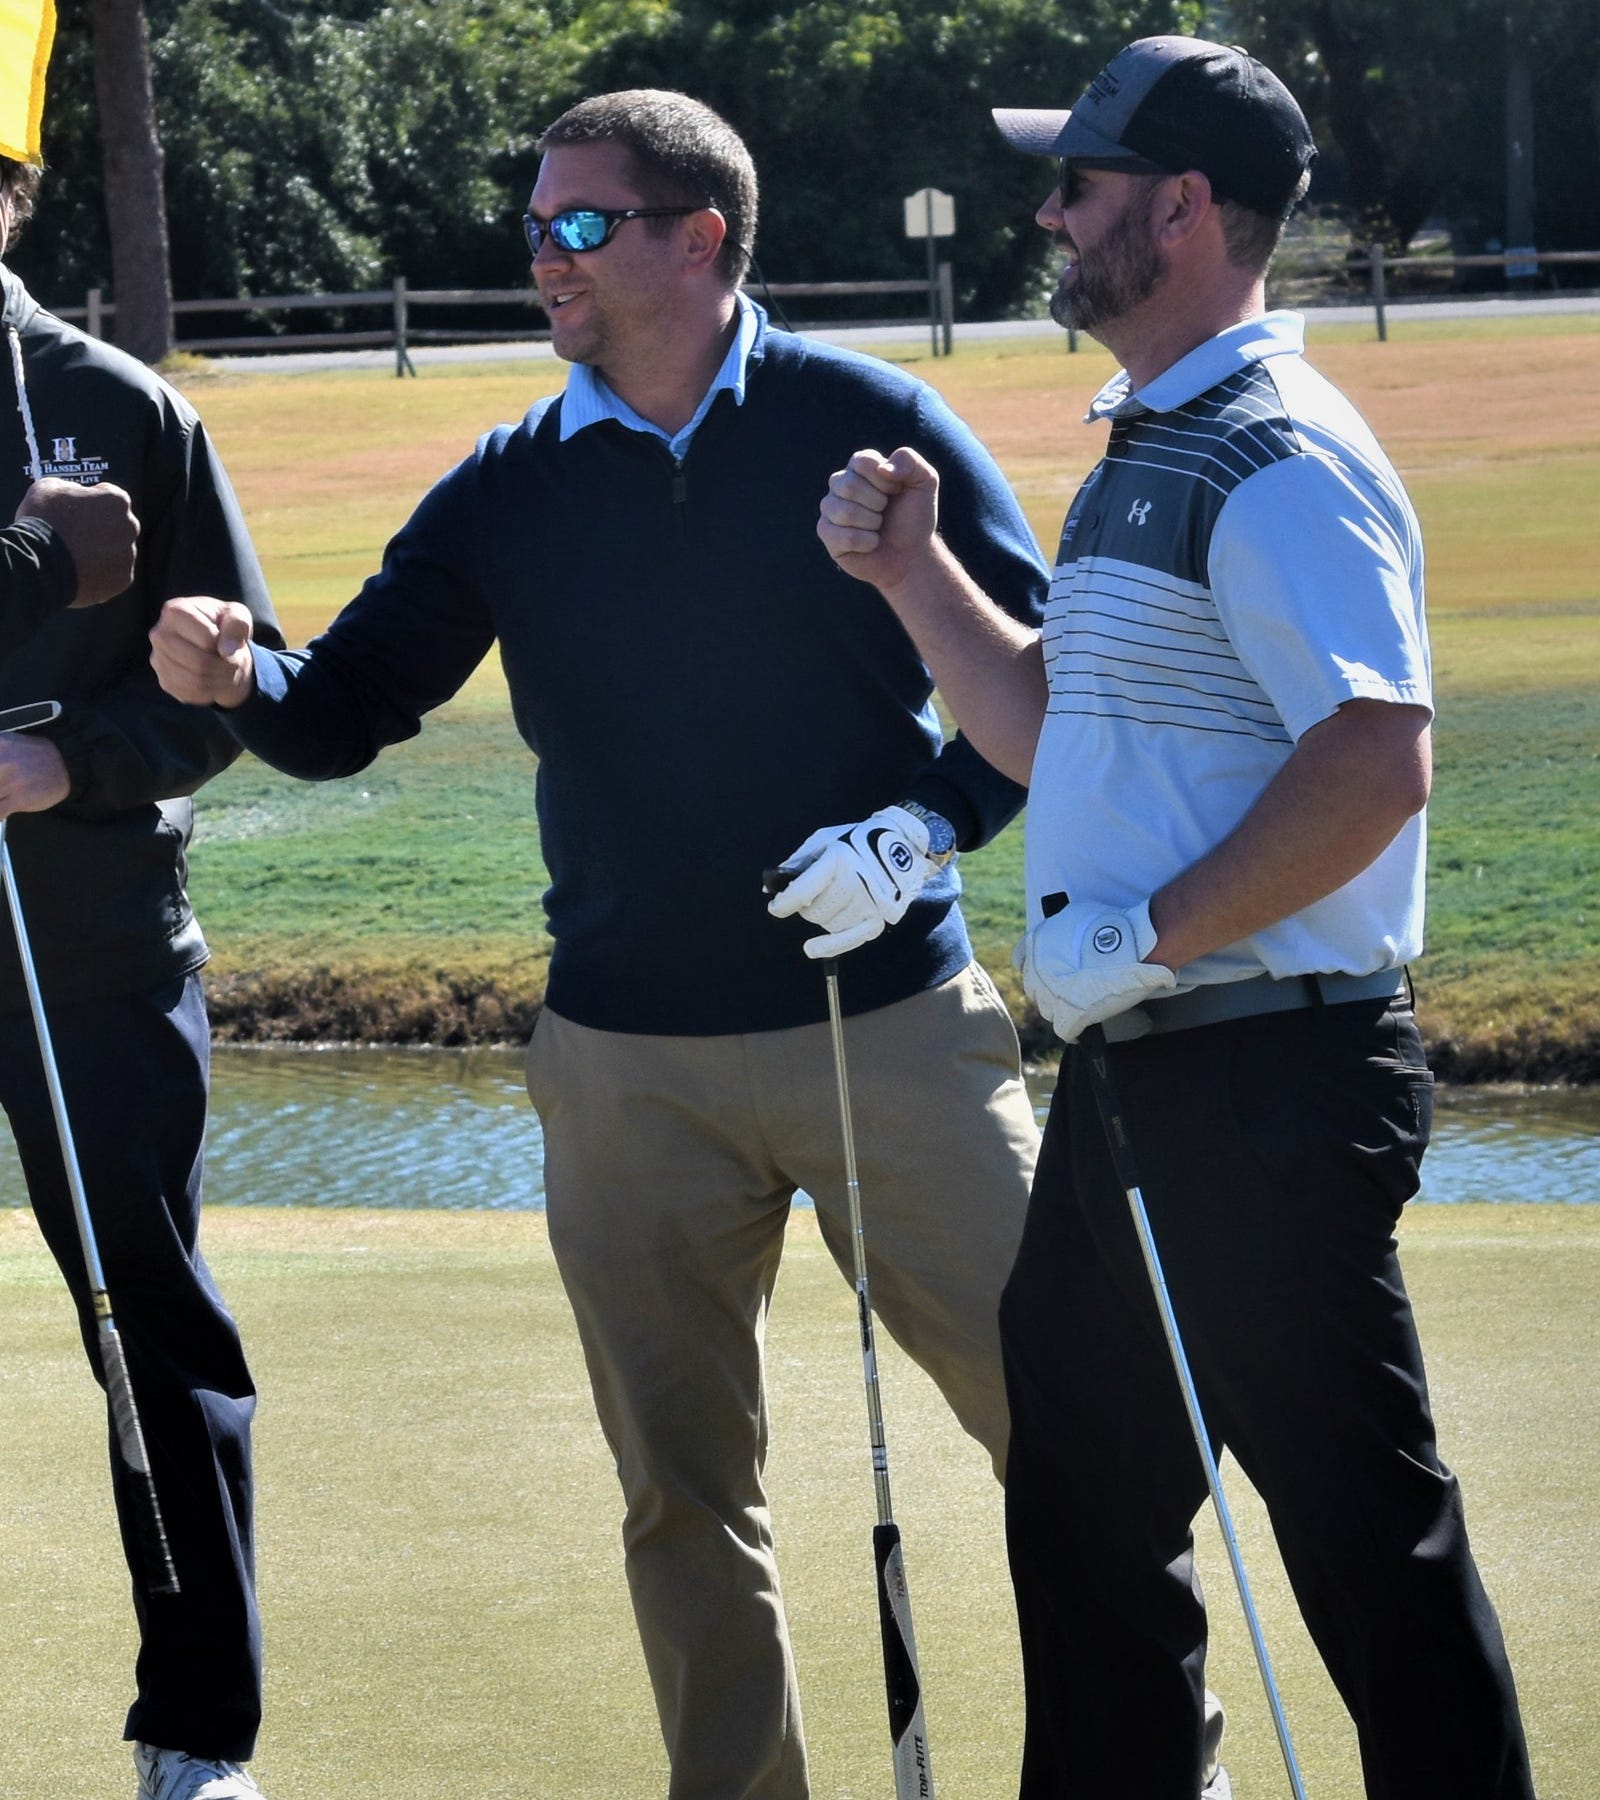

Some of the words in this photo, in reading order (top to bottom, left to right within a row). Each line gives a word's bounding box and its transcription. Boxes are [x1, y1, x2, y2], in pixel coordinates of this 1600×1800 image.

[52, 437, 77, 462] H
[44, 463, 81, 473] HANSEN
[82, 461, 109, 472] TEAM
[914, 1735, 928, 1798] TOP-FLITE
